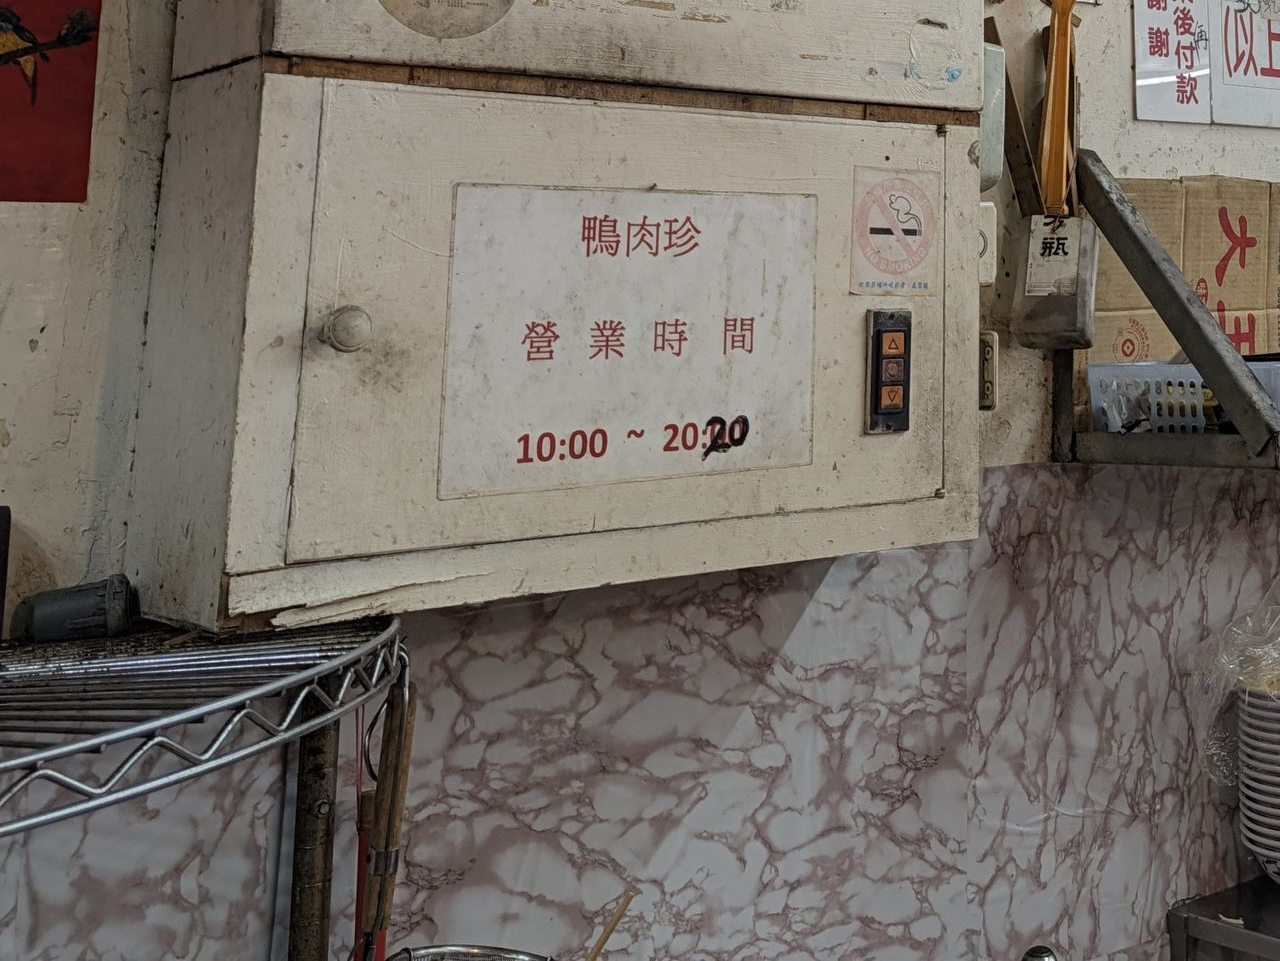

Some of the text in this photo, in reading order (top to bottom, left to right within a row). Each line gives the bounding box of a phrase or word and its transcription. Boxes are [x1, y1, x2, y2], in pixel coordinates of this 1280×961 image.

[581, 214, 702, 258] 鴨肉珍
[521, 316, 756, 363] 營業時間
[516, 428, 608, 464] 10:00
